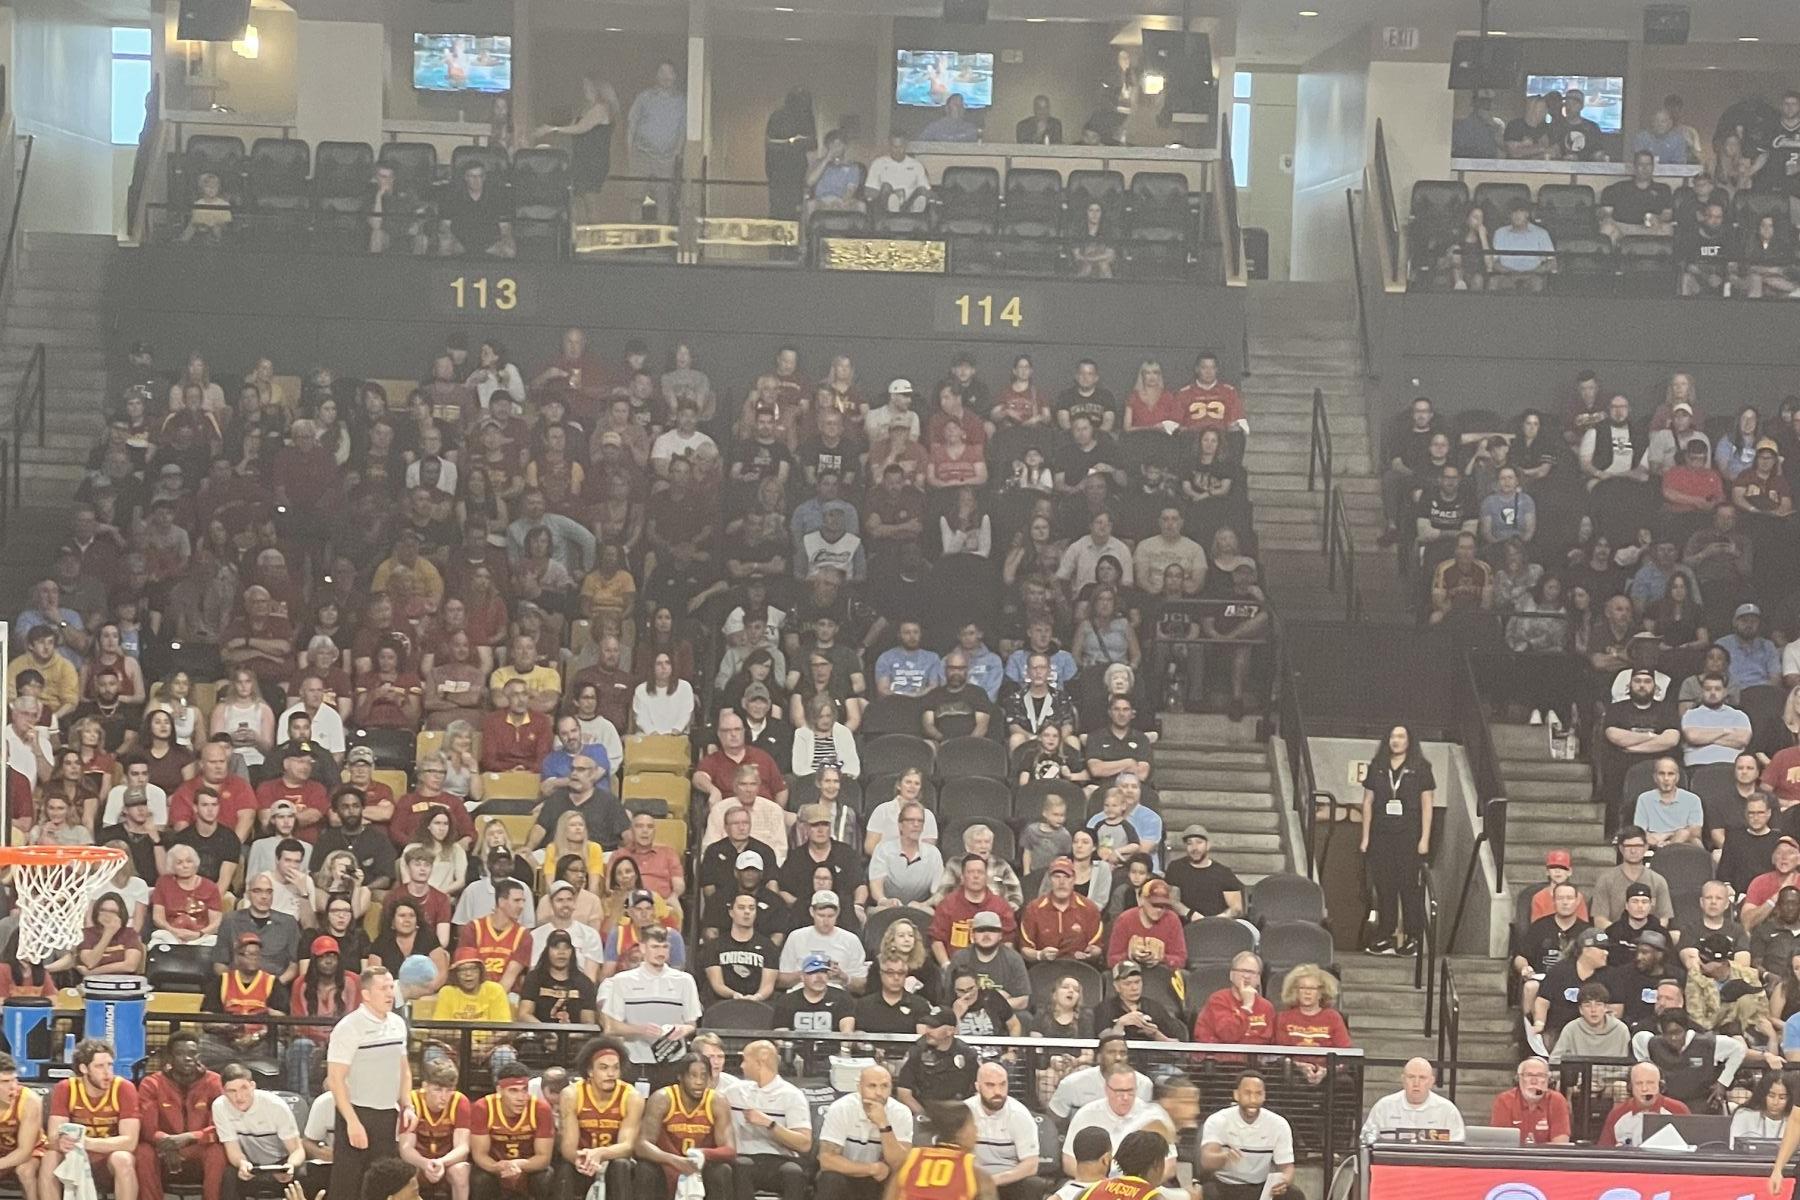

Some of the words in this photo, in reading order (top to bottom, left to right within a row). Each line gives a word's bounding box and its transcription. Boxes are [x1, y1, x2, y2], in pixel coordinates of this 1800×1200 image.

[449, 277, 517, 310] 113
[955, 294, 1023, 327] 114
[484, 957, 506, 973] 22
[719, 951, 765, 967] KNIGHTS
[914, 1158, 956, 1188] 10
